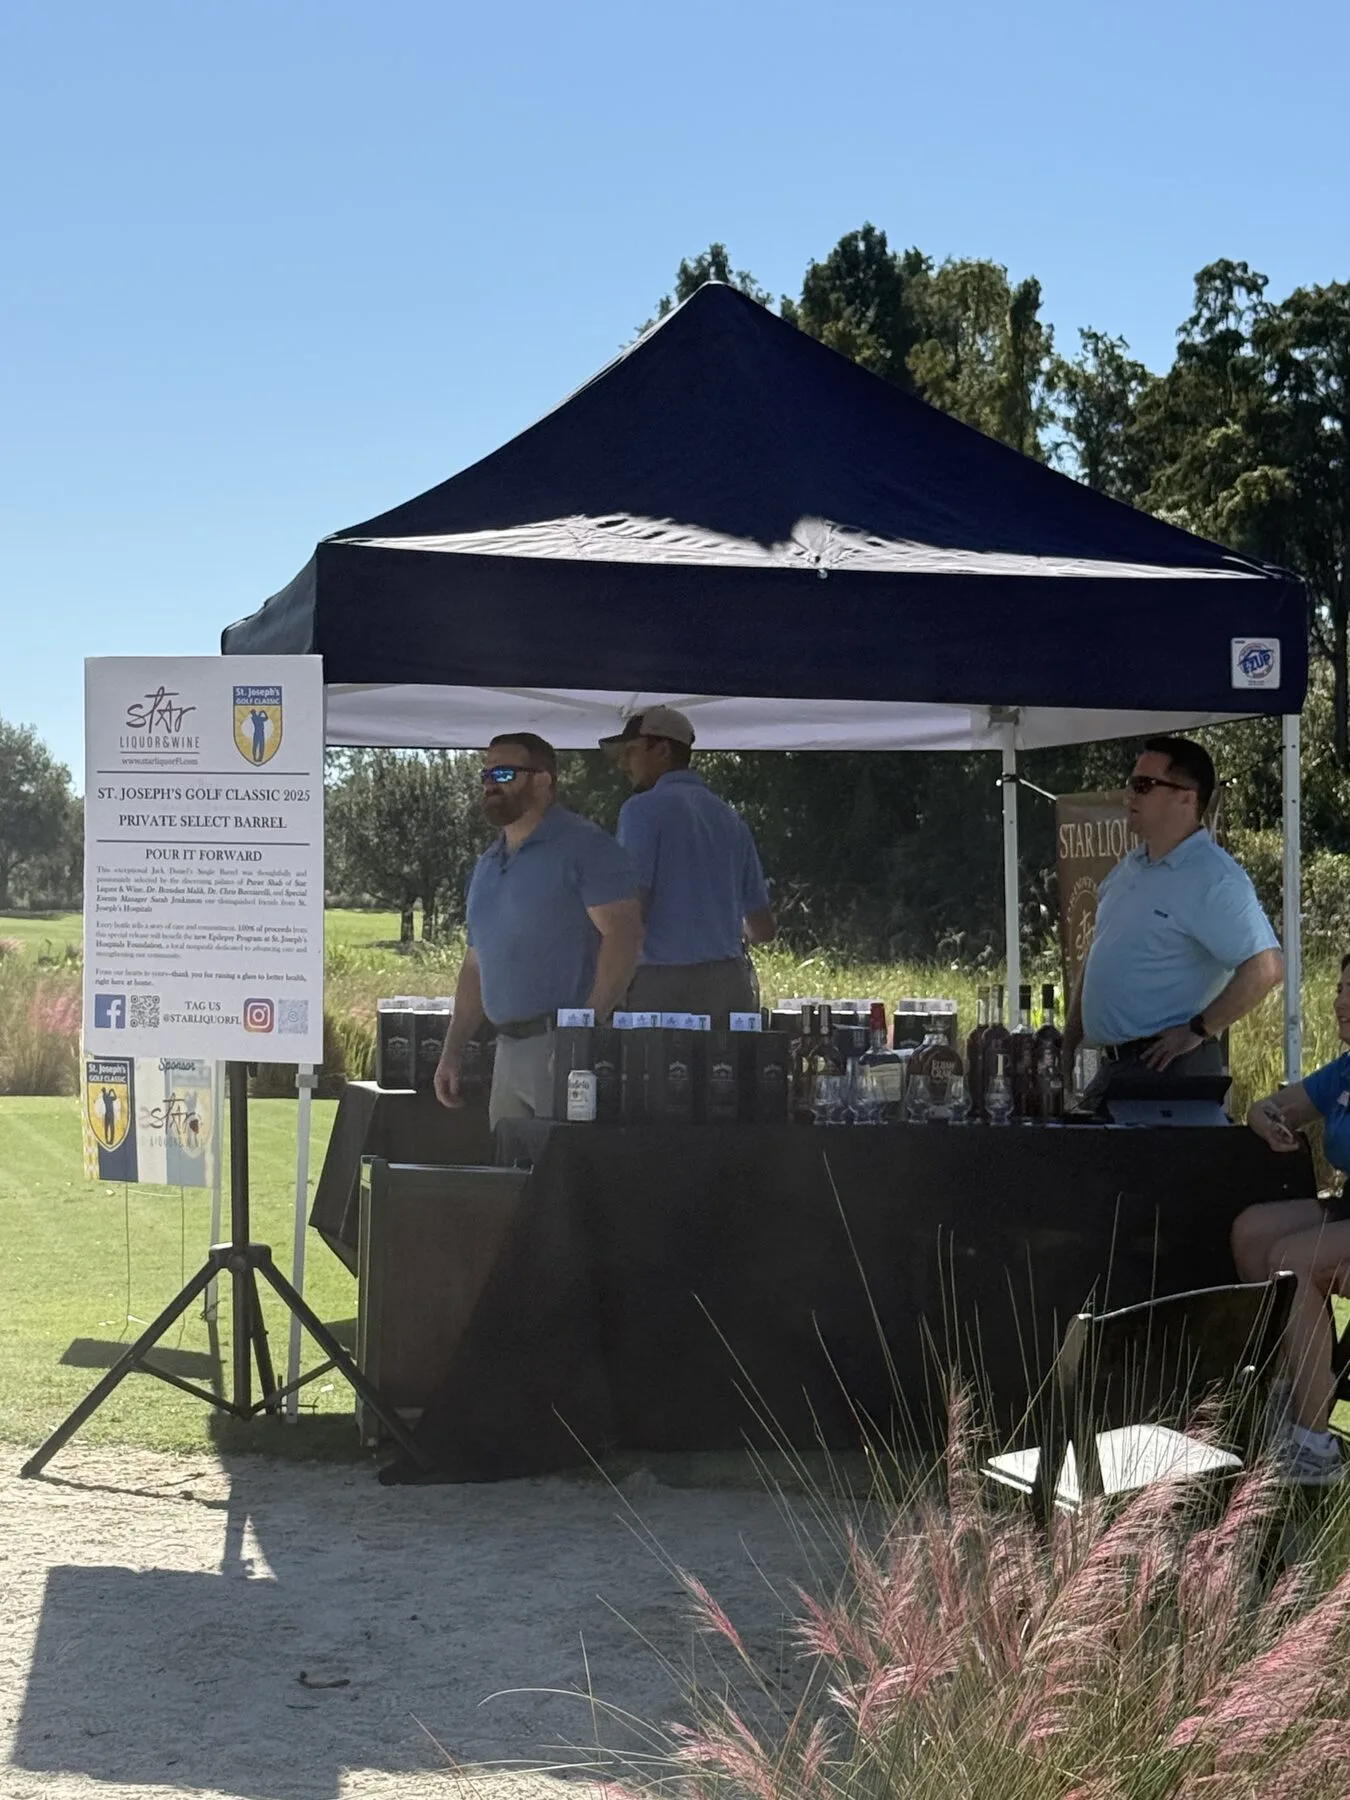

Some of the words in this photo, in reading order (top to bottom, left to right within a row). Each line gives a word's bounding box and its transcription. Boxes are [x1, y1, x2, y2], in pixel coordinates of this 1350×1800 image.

[235, 687, 246, 696] St.
[247, 687, 280, 699] Joseph's
[98, 787, 118, 800] ST.
[120, 787, 182, 801] JOSEPH'S
[186, 788, 221, 801] GOLF
[225, 789, 280, 801] CLASSIC
[283, 789, 310, 801] 2025
[119, 815, 176, 827] PRIVATE
[180, 815, 231, 827] SELECT
[234, 816, 287, 828] BARREL
[1059, 823, 1095, 859] STAR
[146, 849, 179, 860] POUR
[183, 849, 196, 860] IT
[200, 850, 262, 861] FORWARD
[264, 925, 291, 934] proceeds
[237, 934, 262, 942] Program
[185, 1001, 205, 1010] TAG
[208, 1001, 221, 1011] US
[164, 1013, 241, 1025] @STARLIQUORFL
[89, 1064, 98, 1072] St.
[99, 1064, 126, 1075] Joseph's
